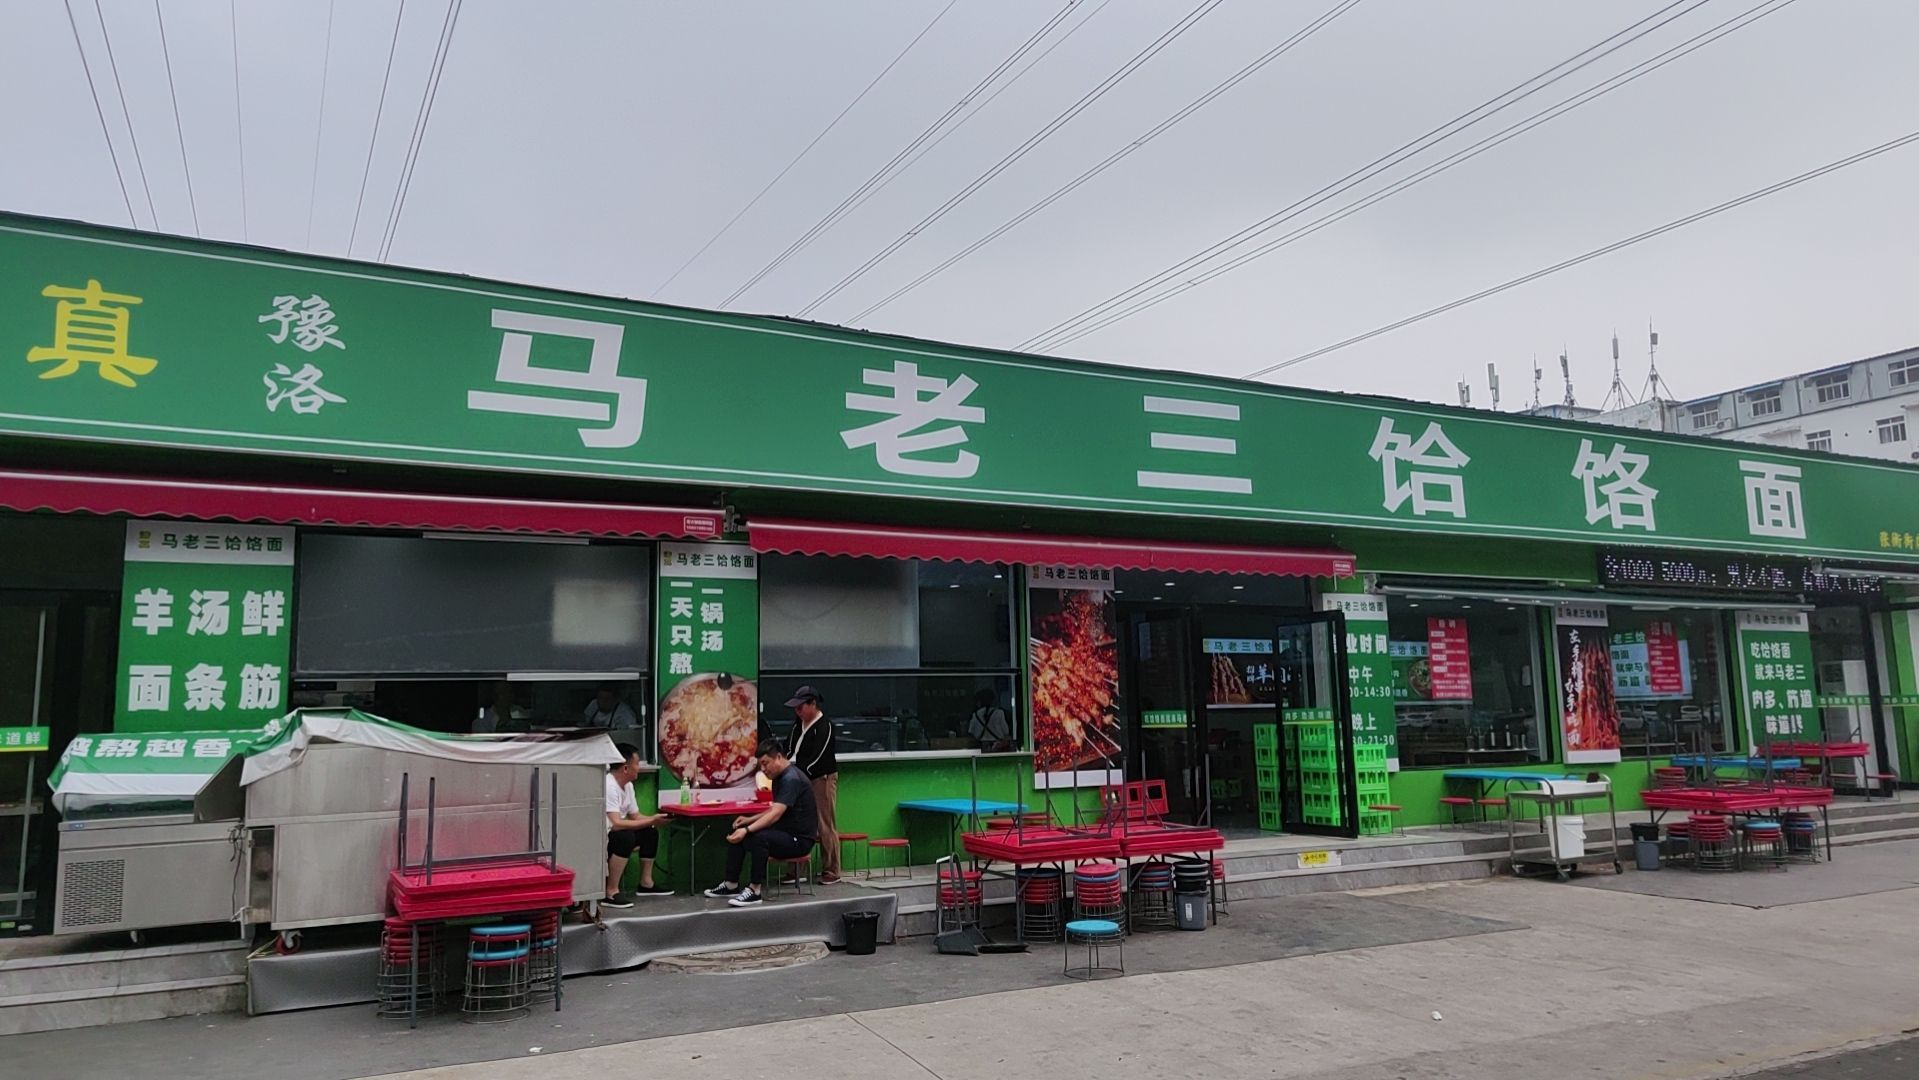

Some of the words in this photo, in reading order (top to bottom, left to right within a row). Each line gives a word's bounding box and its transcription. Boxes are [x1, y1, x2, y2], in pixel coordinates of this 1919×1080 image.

[27, 279, 159, 388] 真
[467, 308, 1807, 540] 马老三饸饹面
[161, 533, 283, 552] 马老三饸饹面
[676, 553, 754, 568] 马老三饸饹面
[132, 588, 285, 636] 羊汤鲜
[701, 588, 724, 652] 一锅汤
[669, 581, 694, 674] 一天只熬
[1334, 633, 1388, 654] 业时间
[1349, 665, 1373, 684] 中午
[1754, 663, 1806, 681] 就来马老三
[127, 663, 282, 711] 面条筋
[1351, 712, 1377, 731] 晚上
[0, 732, 41, 746] 道鲜
